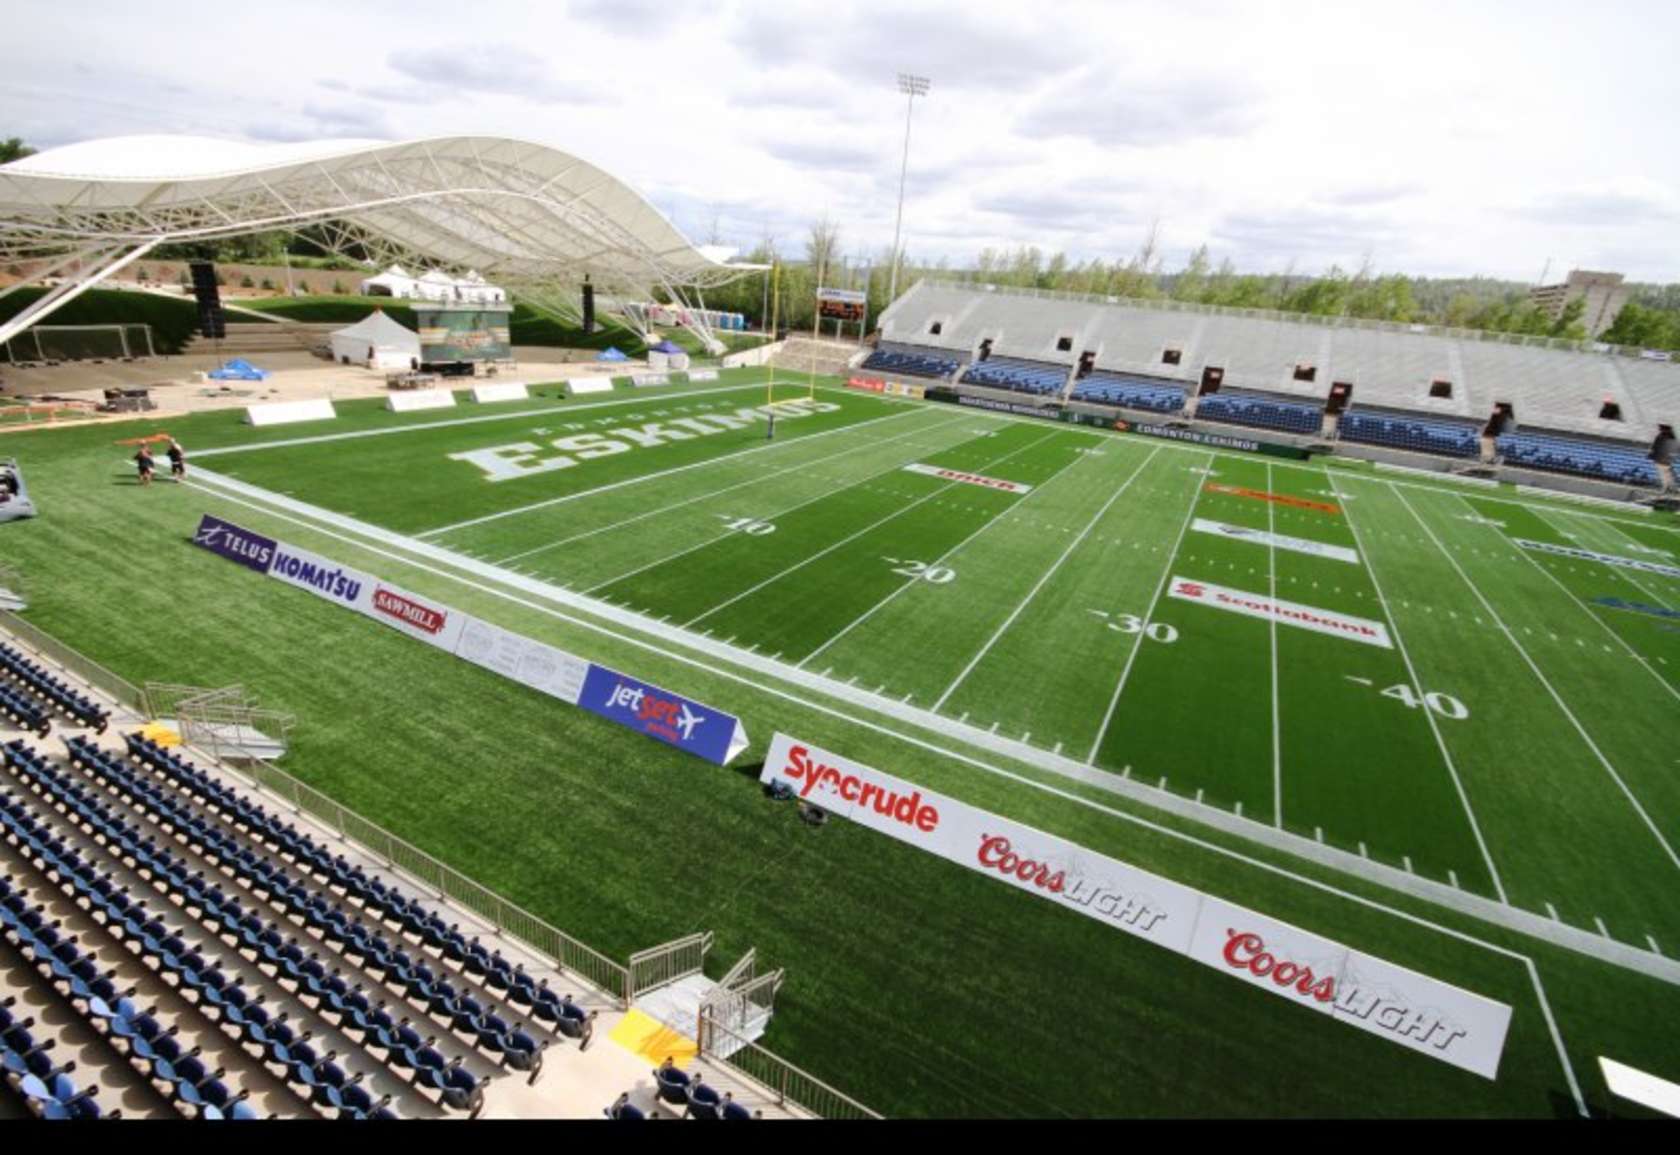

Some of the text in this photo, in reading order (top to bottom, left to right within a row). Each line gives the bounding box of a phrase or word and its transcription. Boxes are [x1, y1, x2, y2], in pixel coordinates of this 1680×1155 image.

[447, 396, 841, 484] ESKIMOS
[224, 533, 272, 564] TELUS
[273, 551, 362, 601] KOMATSU
[889, 559, 956, 585] 20
[375, 592, 437, 631] SAWMILL
[1107, 612, 1180, 644] 30
[1214, 593, 1378, 638] Scotiabank
[1379, 683, 1470, 720] 40
[783, 745, 940, 833] Syncrude
[977, 832, 1168, 932] Coors LIGHT
[1222, 927, 1467, 1051] Coors LIGHT
